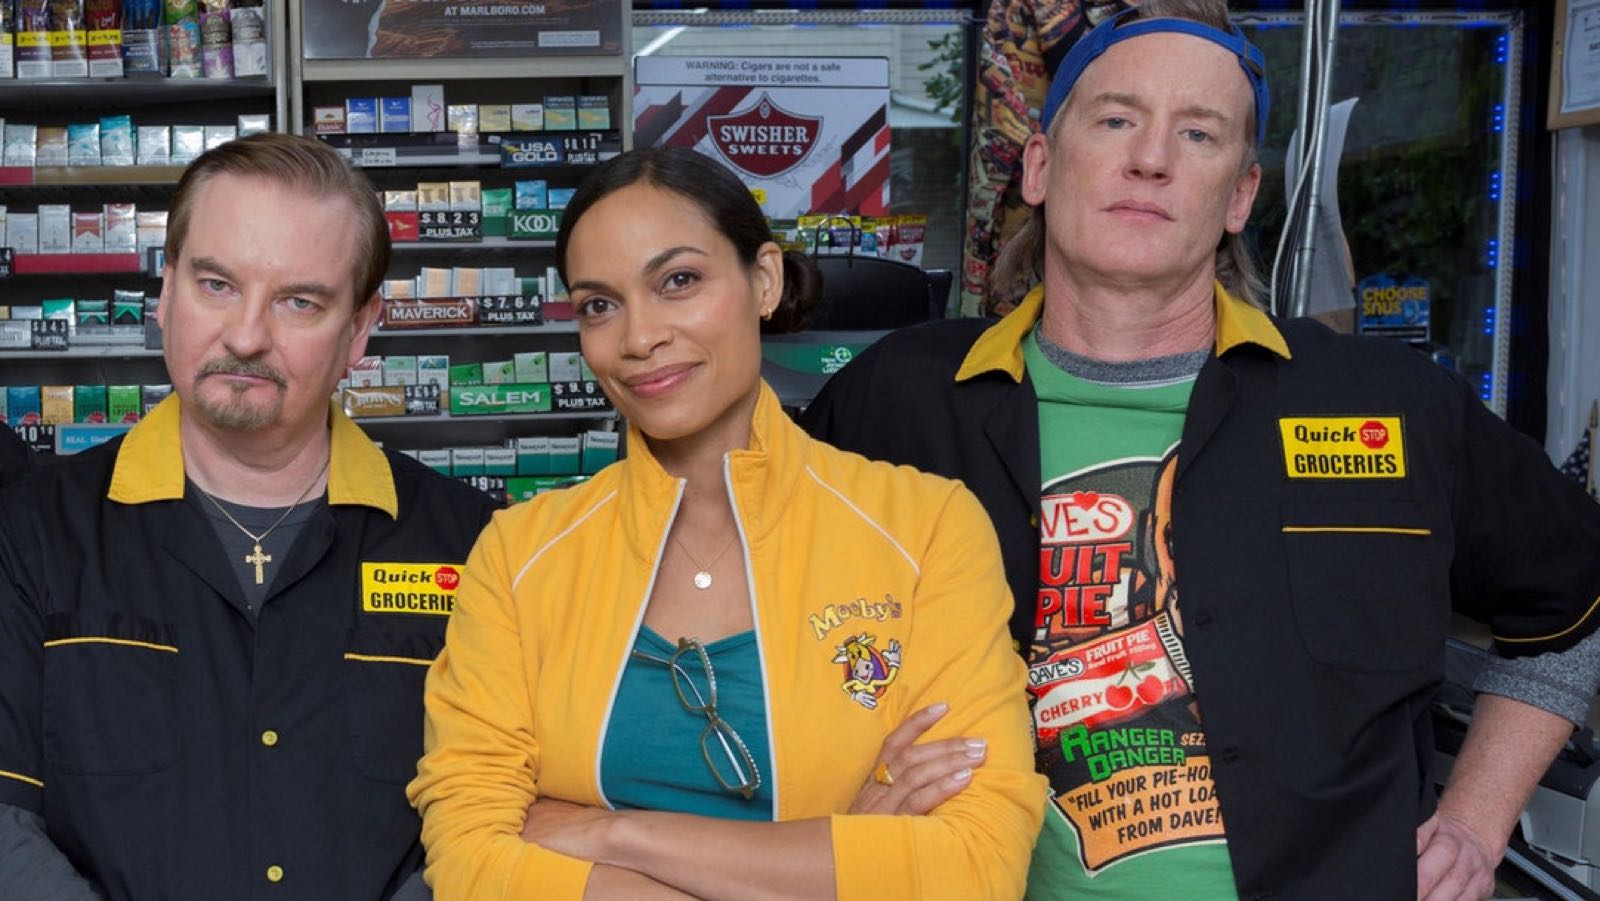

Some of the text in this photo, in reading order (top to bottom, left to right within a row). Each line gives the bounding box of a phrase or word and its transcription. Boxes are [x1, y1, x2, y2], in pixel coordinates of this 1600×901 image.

[444, 5, 545, 16] AT MARLBORO.COM
[686, 61, 841, 72] WARNING: Cigars are not a safe
[704, 73, 820, 83] alternative to cigarettes.
[719, 125, 809, 143] SWISHER
[520, 142, 556, 152] USA
[728, 144, 803, 156] SWEETS
[512, 151, 558, 162] GOLD
[426, 227, 474, 238] PLUS TAX
[513, 215, 560, 233] KOOL
[1362, 287, 1425, 301] CHOOSE
[391, 306, 468, 320] MAVERICK
[487, 311, 535, 321] PLUS TAX
[1362, 300, 1402, 316] SNUS
[459, 391, 541, 406] SALEM
[558, 397, 606, 408] PLUS TAX
[1294, 424, 1386, 444] Quick STOP
[1294, 454, 1397, 474] GROCERIES
[1041, 499, 1123, 538] VES
[373, 568, 458, 584] Quick STOP
[1034, 584, 1112, 628] PIE
[808, 593, 902, 640] Mooby's
[1085, 629, 1151, 664] FRUIT PIE
[1028, 659, 1080, 685] DAVE'S
[1040, 691, 1104, 723] CHERRY
[1059, 724, 1175, 763] RANGER
[1087, 746, 1186, 781] DANGER
[1067, 788, 1103, 813] "FILL
[1106, 777, 1147, 800] YOUR
[1088, 803, 1127, 832] WITH
[1132, 797, 1144, 817] A
[1150, 789, 1182, 813] HOT
[1117, 805, 1221, 844] FROM DAVE!
